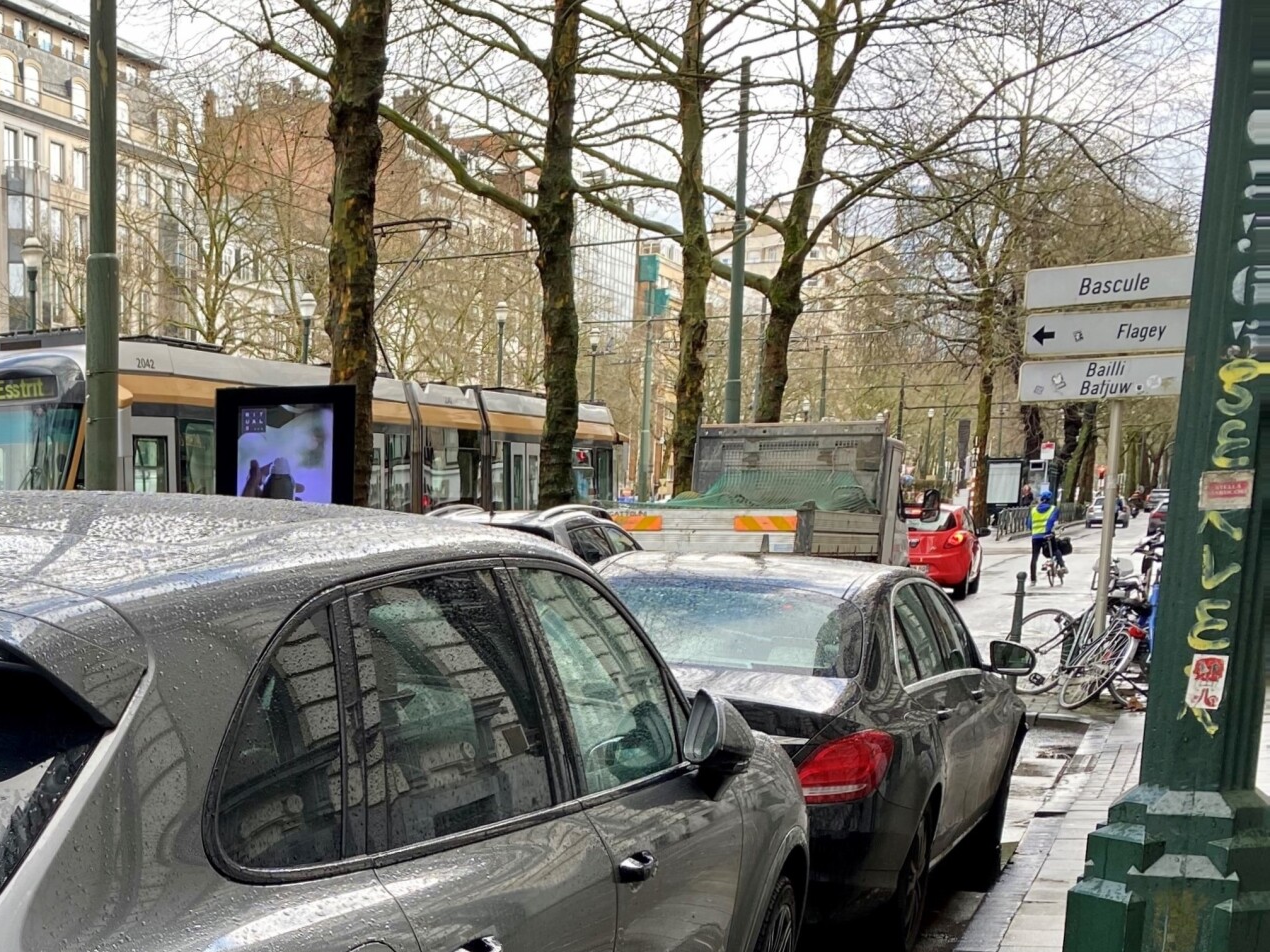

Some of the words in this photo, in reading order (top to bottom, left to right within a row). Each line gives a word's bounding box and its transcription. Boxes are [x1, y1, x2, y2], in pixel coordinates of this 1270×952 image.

[1079, 273, 1150, 296] Bascule
[1117, 323, 1167, 343] Flagey
[136, 357, 155, 370] 2042
[1086, 361, 1127, 377] Bailli
